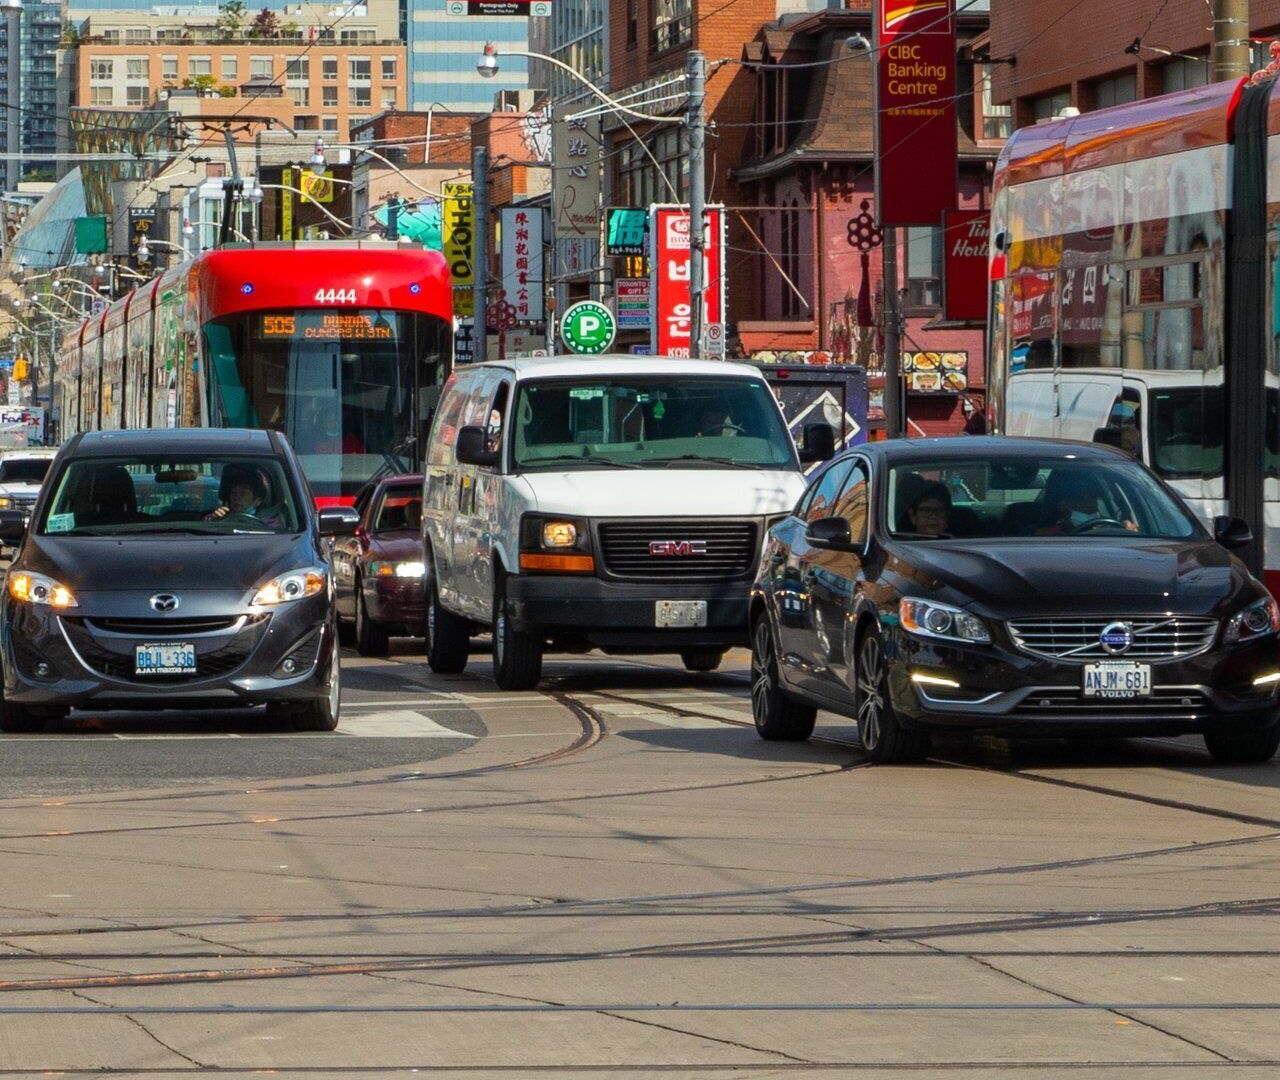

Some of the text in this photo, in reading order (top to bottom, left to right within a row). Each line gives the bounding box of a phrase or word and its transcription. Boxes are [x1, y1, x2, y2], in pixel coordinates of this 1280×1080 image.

[887, 45, 922, 60] CIBC
[888, 62, 947, 81] Banking
[888, 80, 938, 95] Centre
[451, 197, 472, 278] PHOTO
[314, 288, 357, 304] 4444
[566, 305, 610, 323] MUNICIPAL
[263, 314, 372, 334] 505 DUNDAS
[305, 327, 353, 338] DUNDAS
[580, 316, 600, 336] P
[565, 332, 612, 353] PARKING
[648, 540, 707, 556] GMC
[173, 651, 194, 668] 336
[1086, 671, 1149, 689] ANJM 681
[1101, 690, 1135, 698] VOLVO
